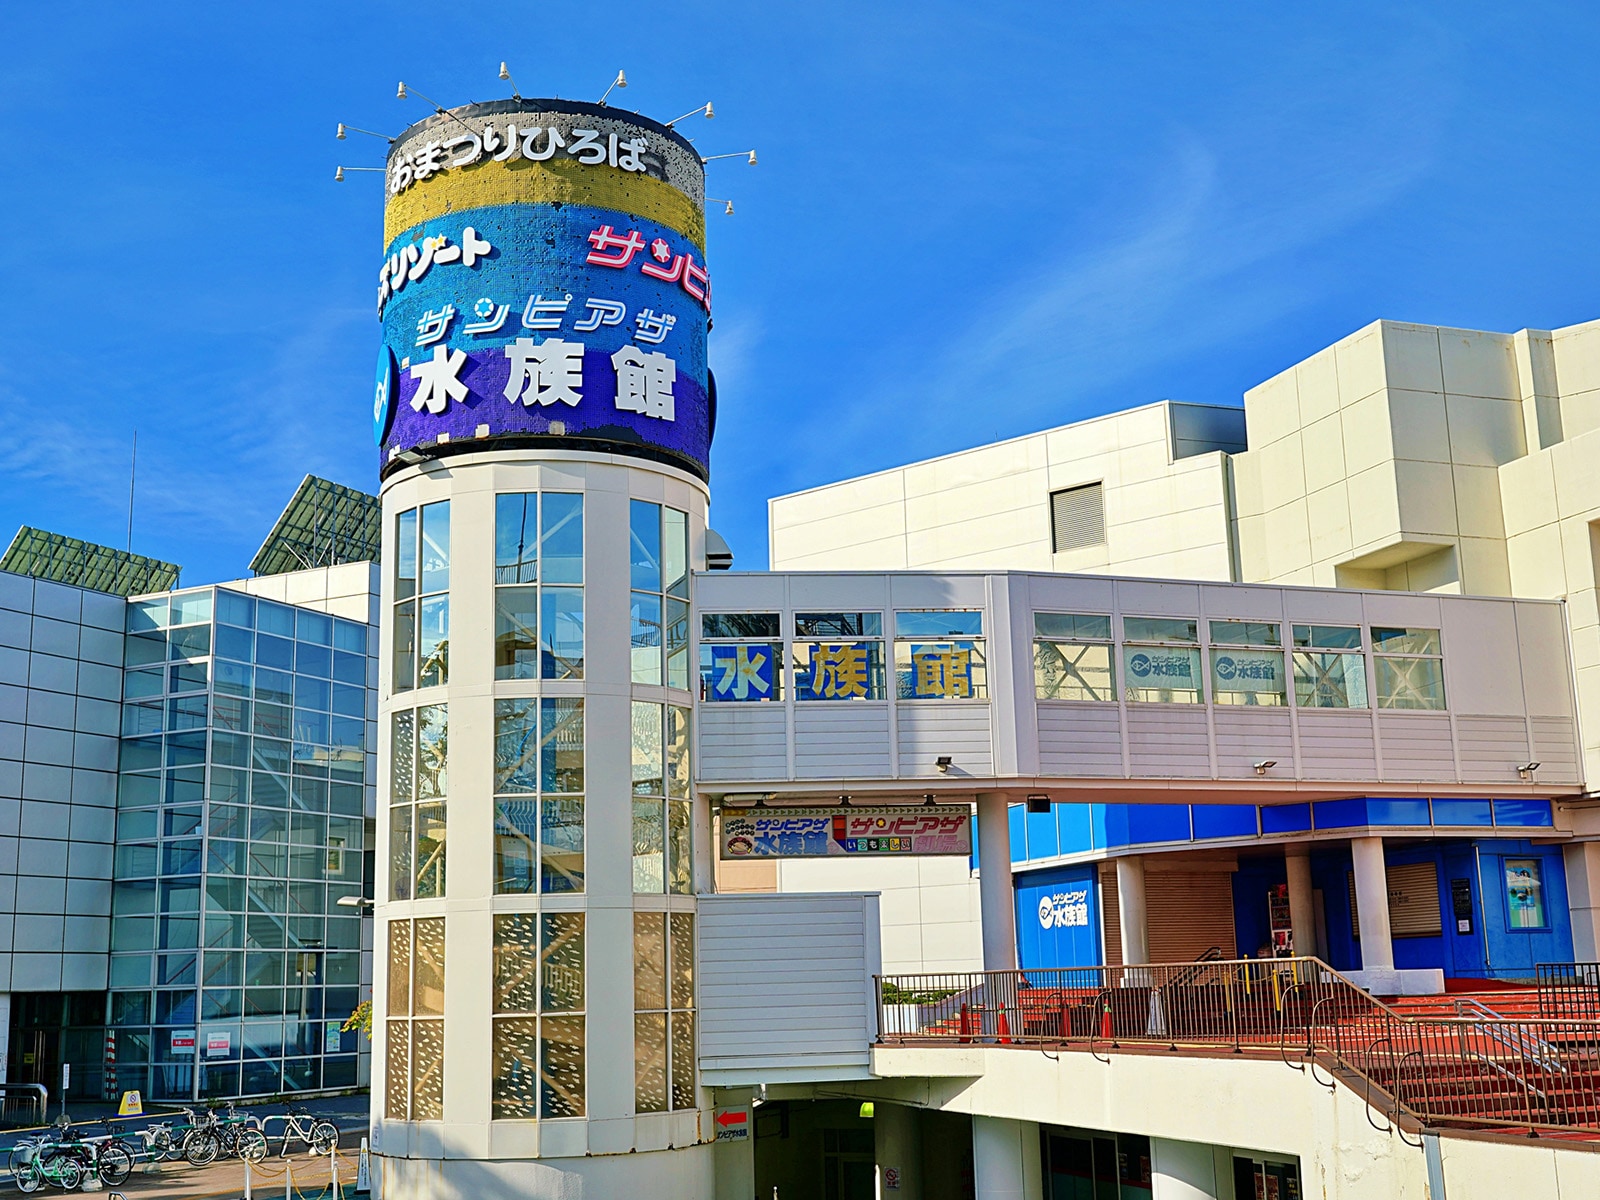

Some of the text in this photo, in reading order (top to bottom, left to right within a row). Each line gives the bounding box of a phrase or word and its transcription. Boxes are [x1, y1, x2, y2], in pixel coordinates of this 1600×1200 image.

[390, 124, 648, 194] おまつりひろば
[415, 294, 677, 347] サンピアザ
[410, 338, 677, 422] 水族館
[715, 644, 970, 699] 水族館
[1152, 662, 1192, 678] 水族館
[1237, 666, 1275, 680] 水族館
[755, 818, 831, 831] サンピアザ
[850, 815, 967, 834] サンピアザ
[754, 831, 829, 855] 水族館
[1053, 902, 1088, 928] 水族館
